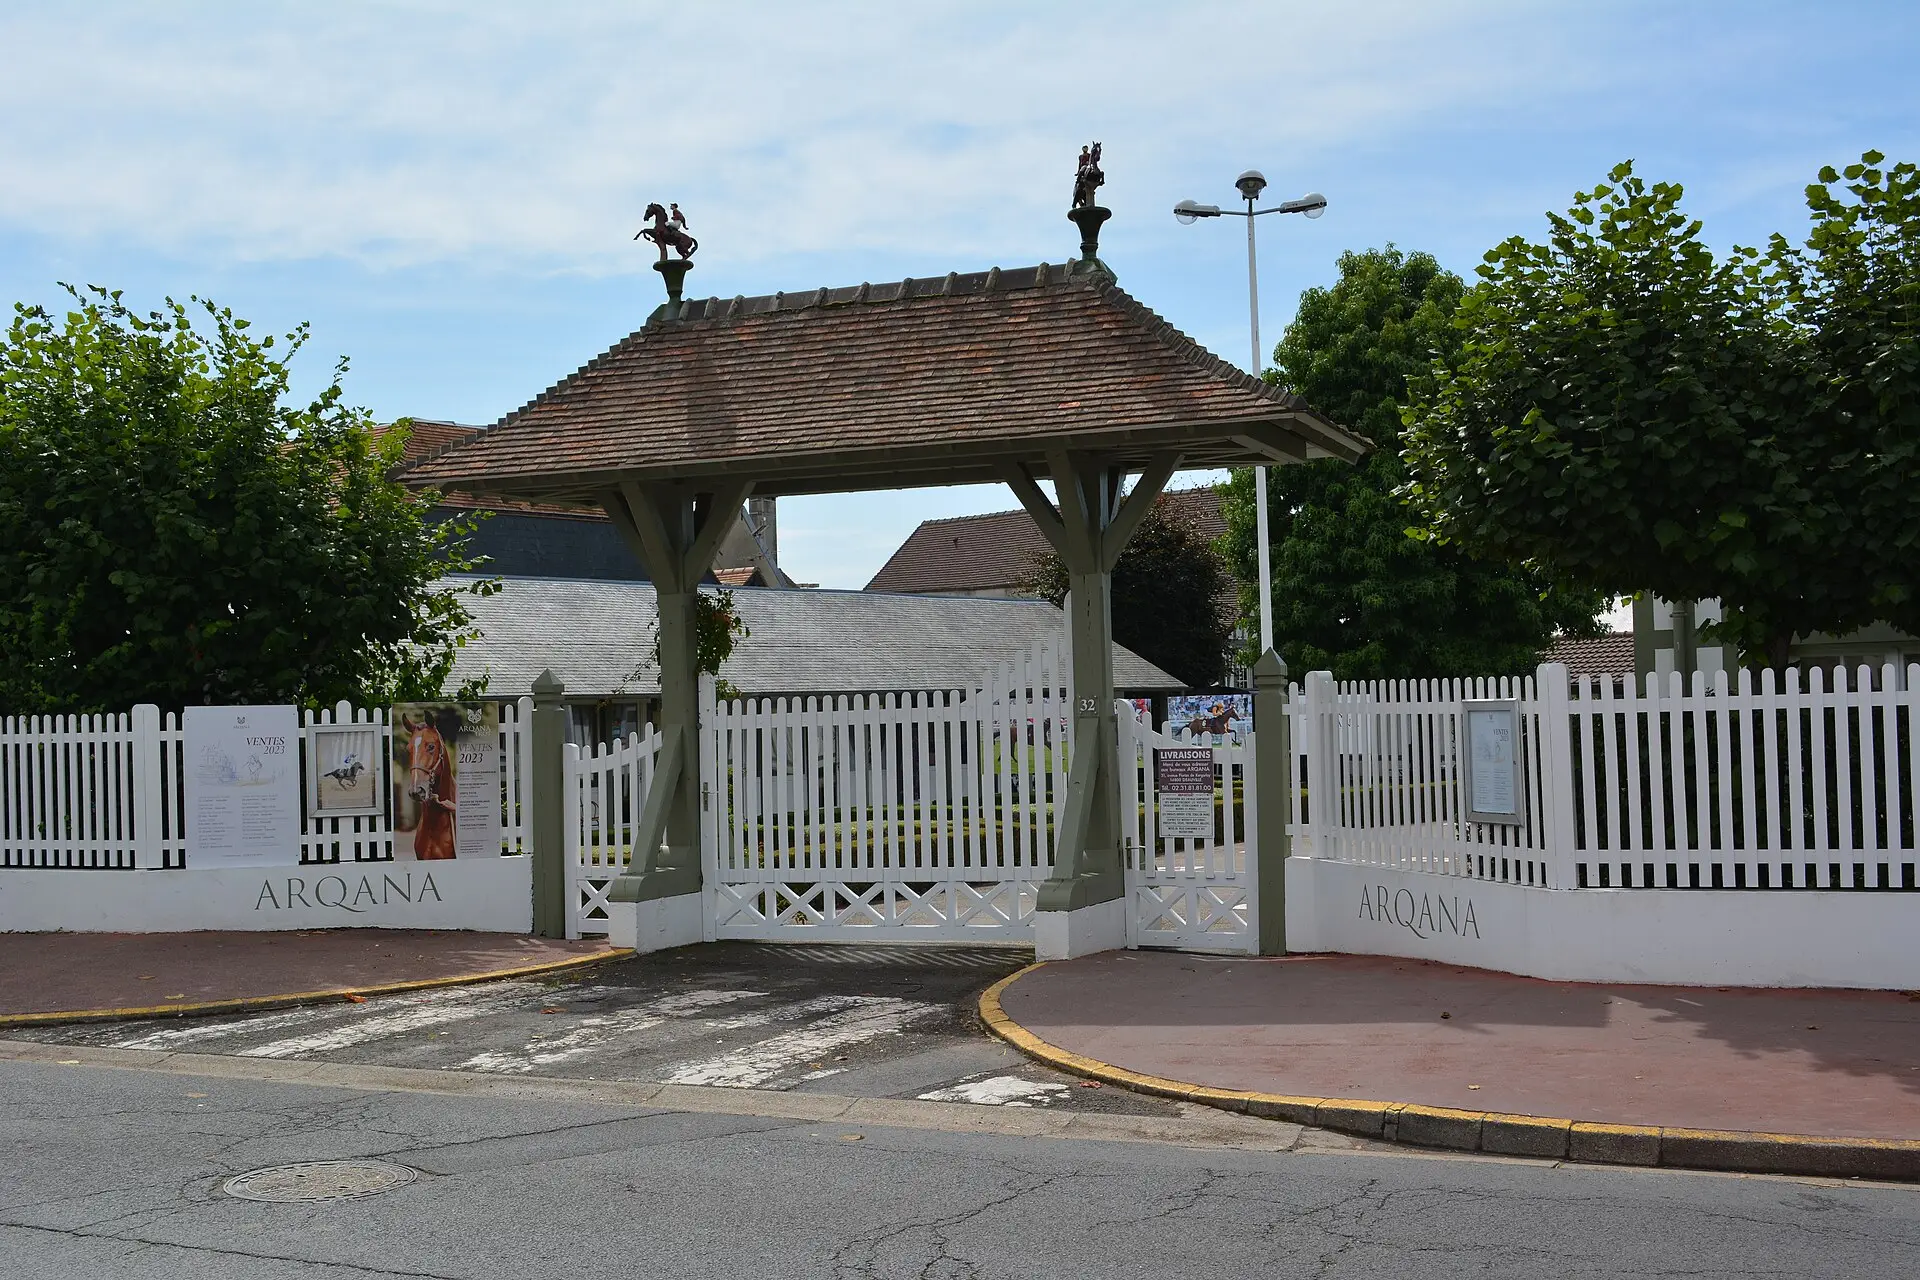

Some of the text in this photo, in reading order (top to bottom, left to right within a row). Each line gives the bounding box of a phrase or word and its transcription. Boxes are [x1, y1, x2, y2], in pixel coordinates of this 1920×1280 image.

[1079, 699, 1095, 711] 32
[1493, 728, 1509, 736] VENTES
[246, 736, 285, 746] VENTES
[263, 745, 285, 755] 2023
[458, 743, 493, 751] VENTES
[458, 752, 484, 764] 2023
[1160, 750, 1211, 759] LIVRAISONS
[254, 872, 443, 913] ARQANA
[1358, 883, 1481, 939] ARQANA
